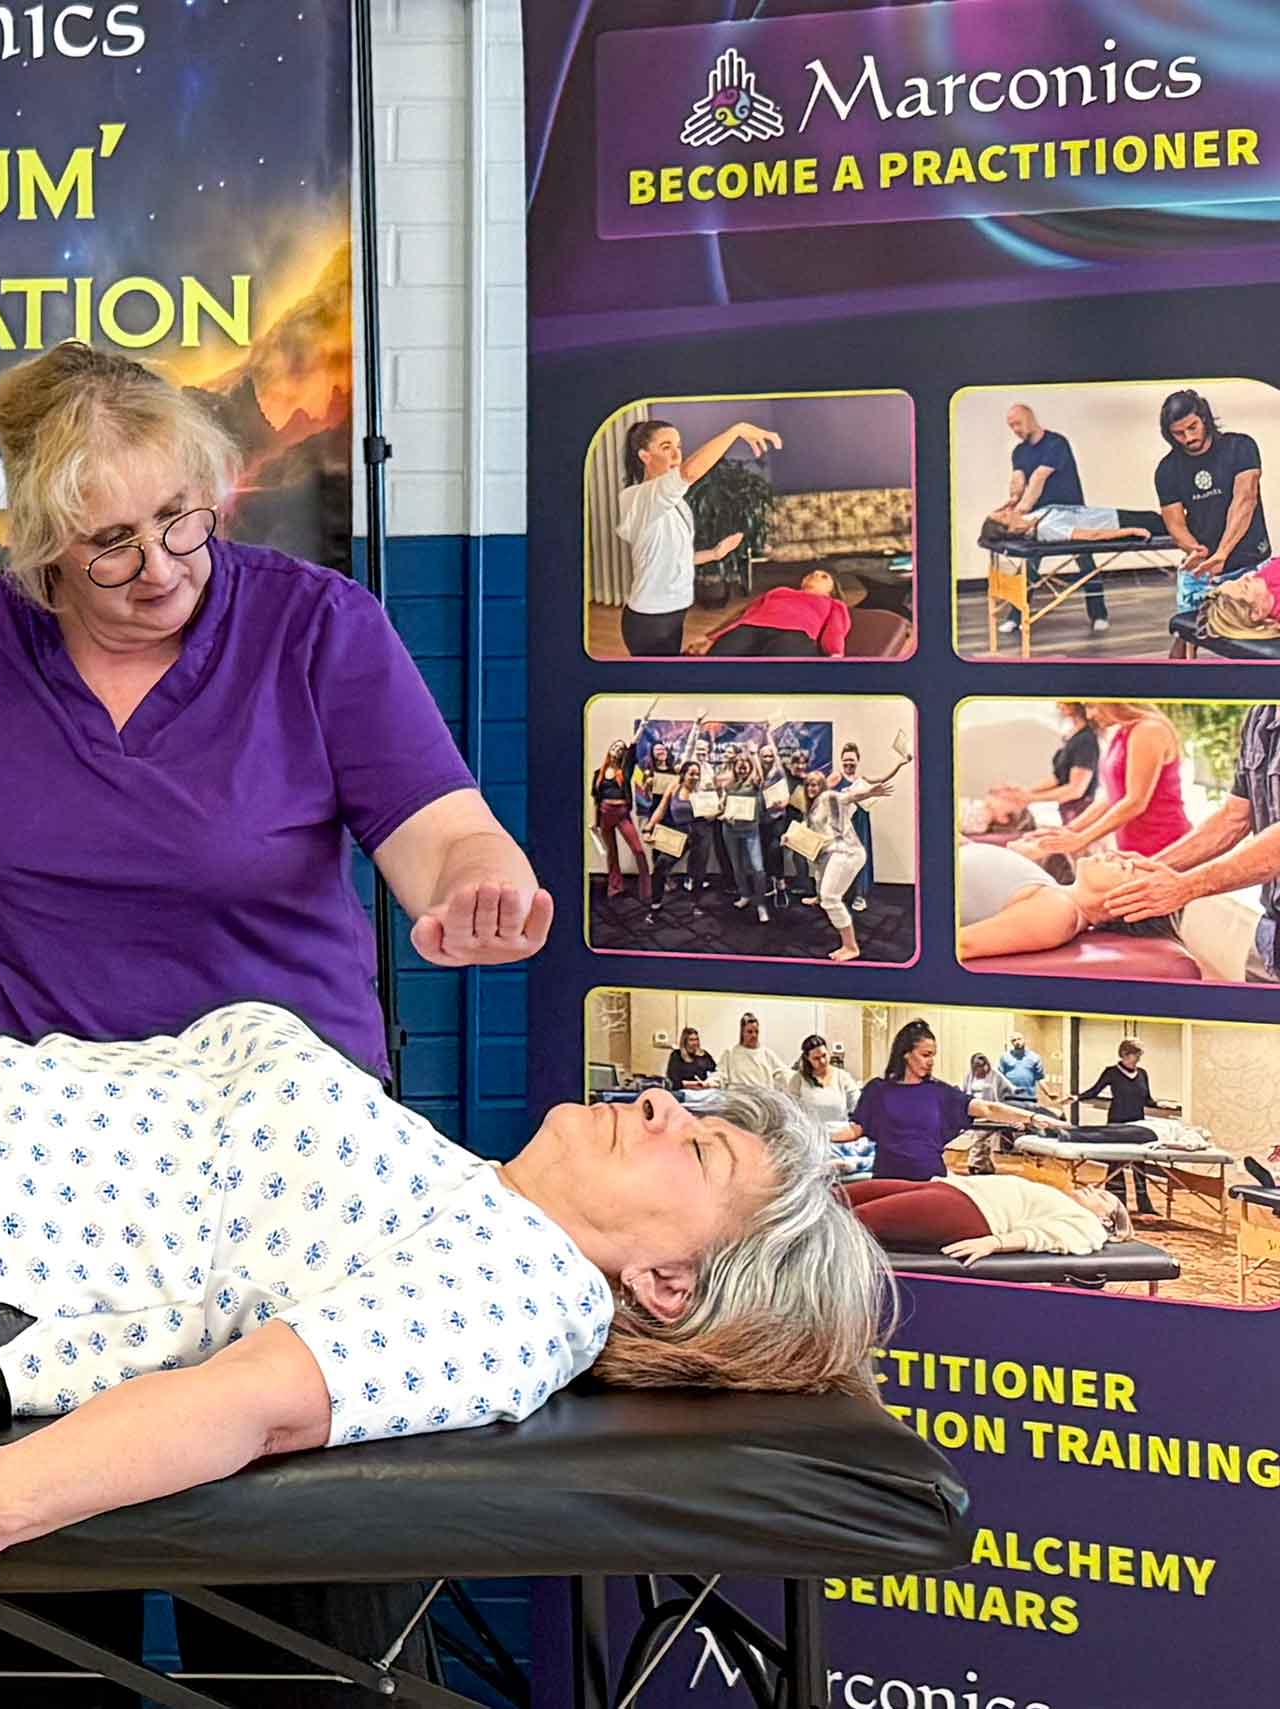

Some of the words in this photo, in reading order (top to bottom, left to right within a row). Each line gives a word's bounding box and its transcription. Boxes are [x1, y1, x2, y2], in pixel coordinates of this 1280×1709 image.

[798, 39, 1202, 132] Marconics
[629, 158, 818, 205] BECOME
[833, 155, 864, 192] A
[880, 128, 1260, 188] PRACTITIONER
[1023, 1420, 1280, 1488] TRAINING
[972, 1528, 1217, 1596] ALCHEMY
